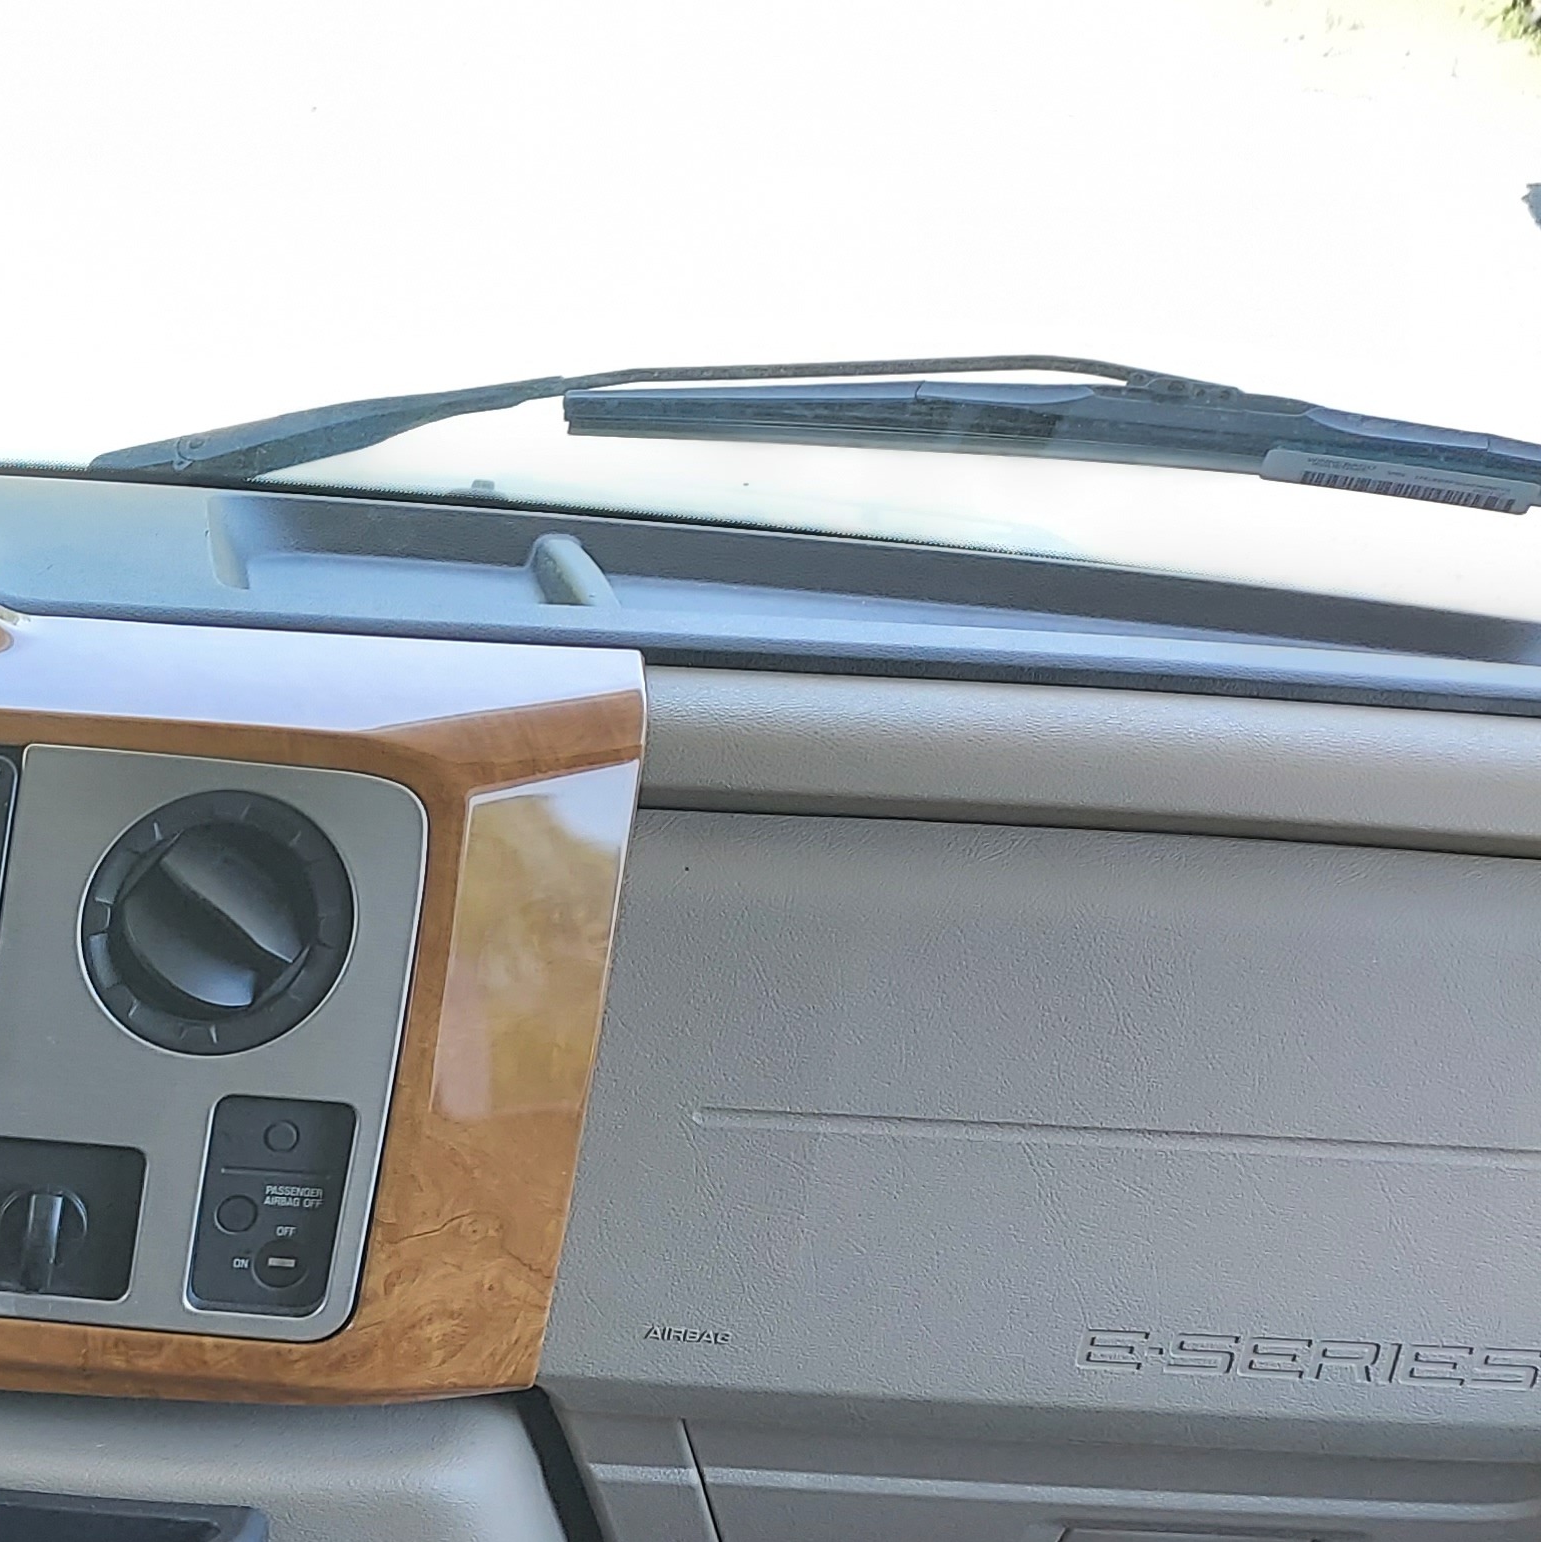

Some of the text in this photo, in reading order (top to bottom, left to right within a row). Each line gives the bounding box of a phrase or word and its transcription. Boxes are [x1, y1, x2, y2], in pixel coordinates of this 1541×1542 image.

[265, 1185, 323, 1198] PASSENGER
[263, 1196, 323, 1208] AIRBAG OFF
[276, 1226, 297, 1236] OFF
[233, 1258, 249, 1268] ON
[644, 1326, 732, 1344] AIRBAG
[1077, 1327, 1541, 1390] E-SERIES
